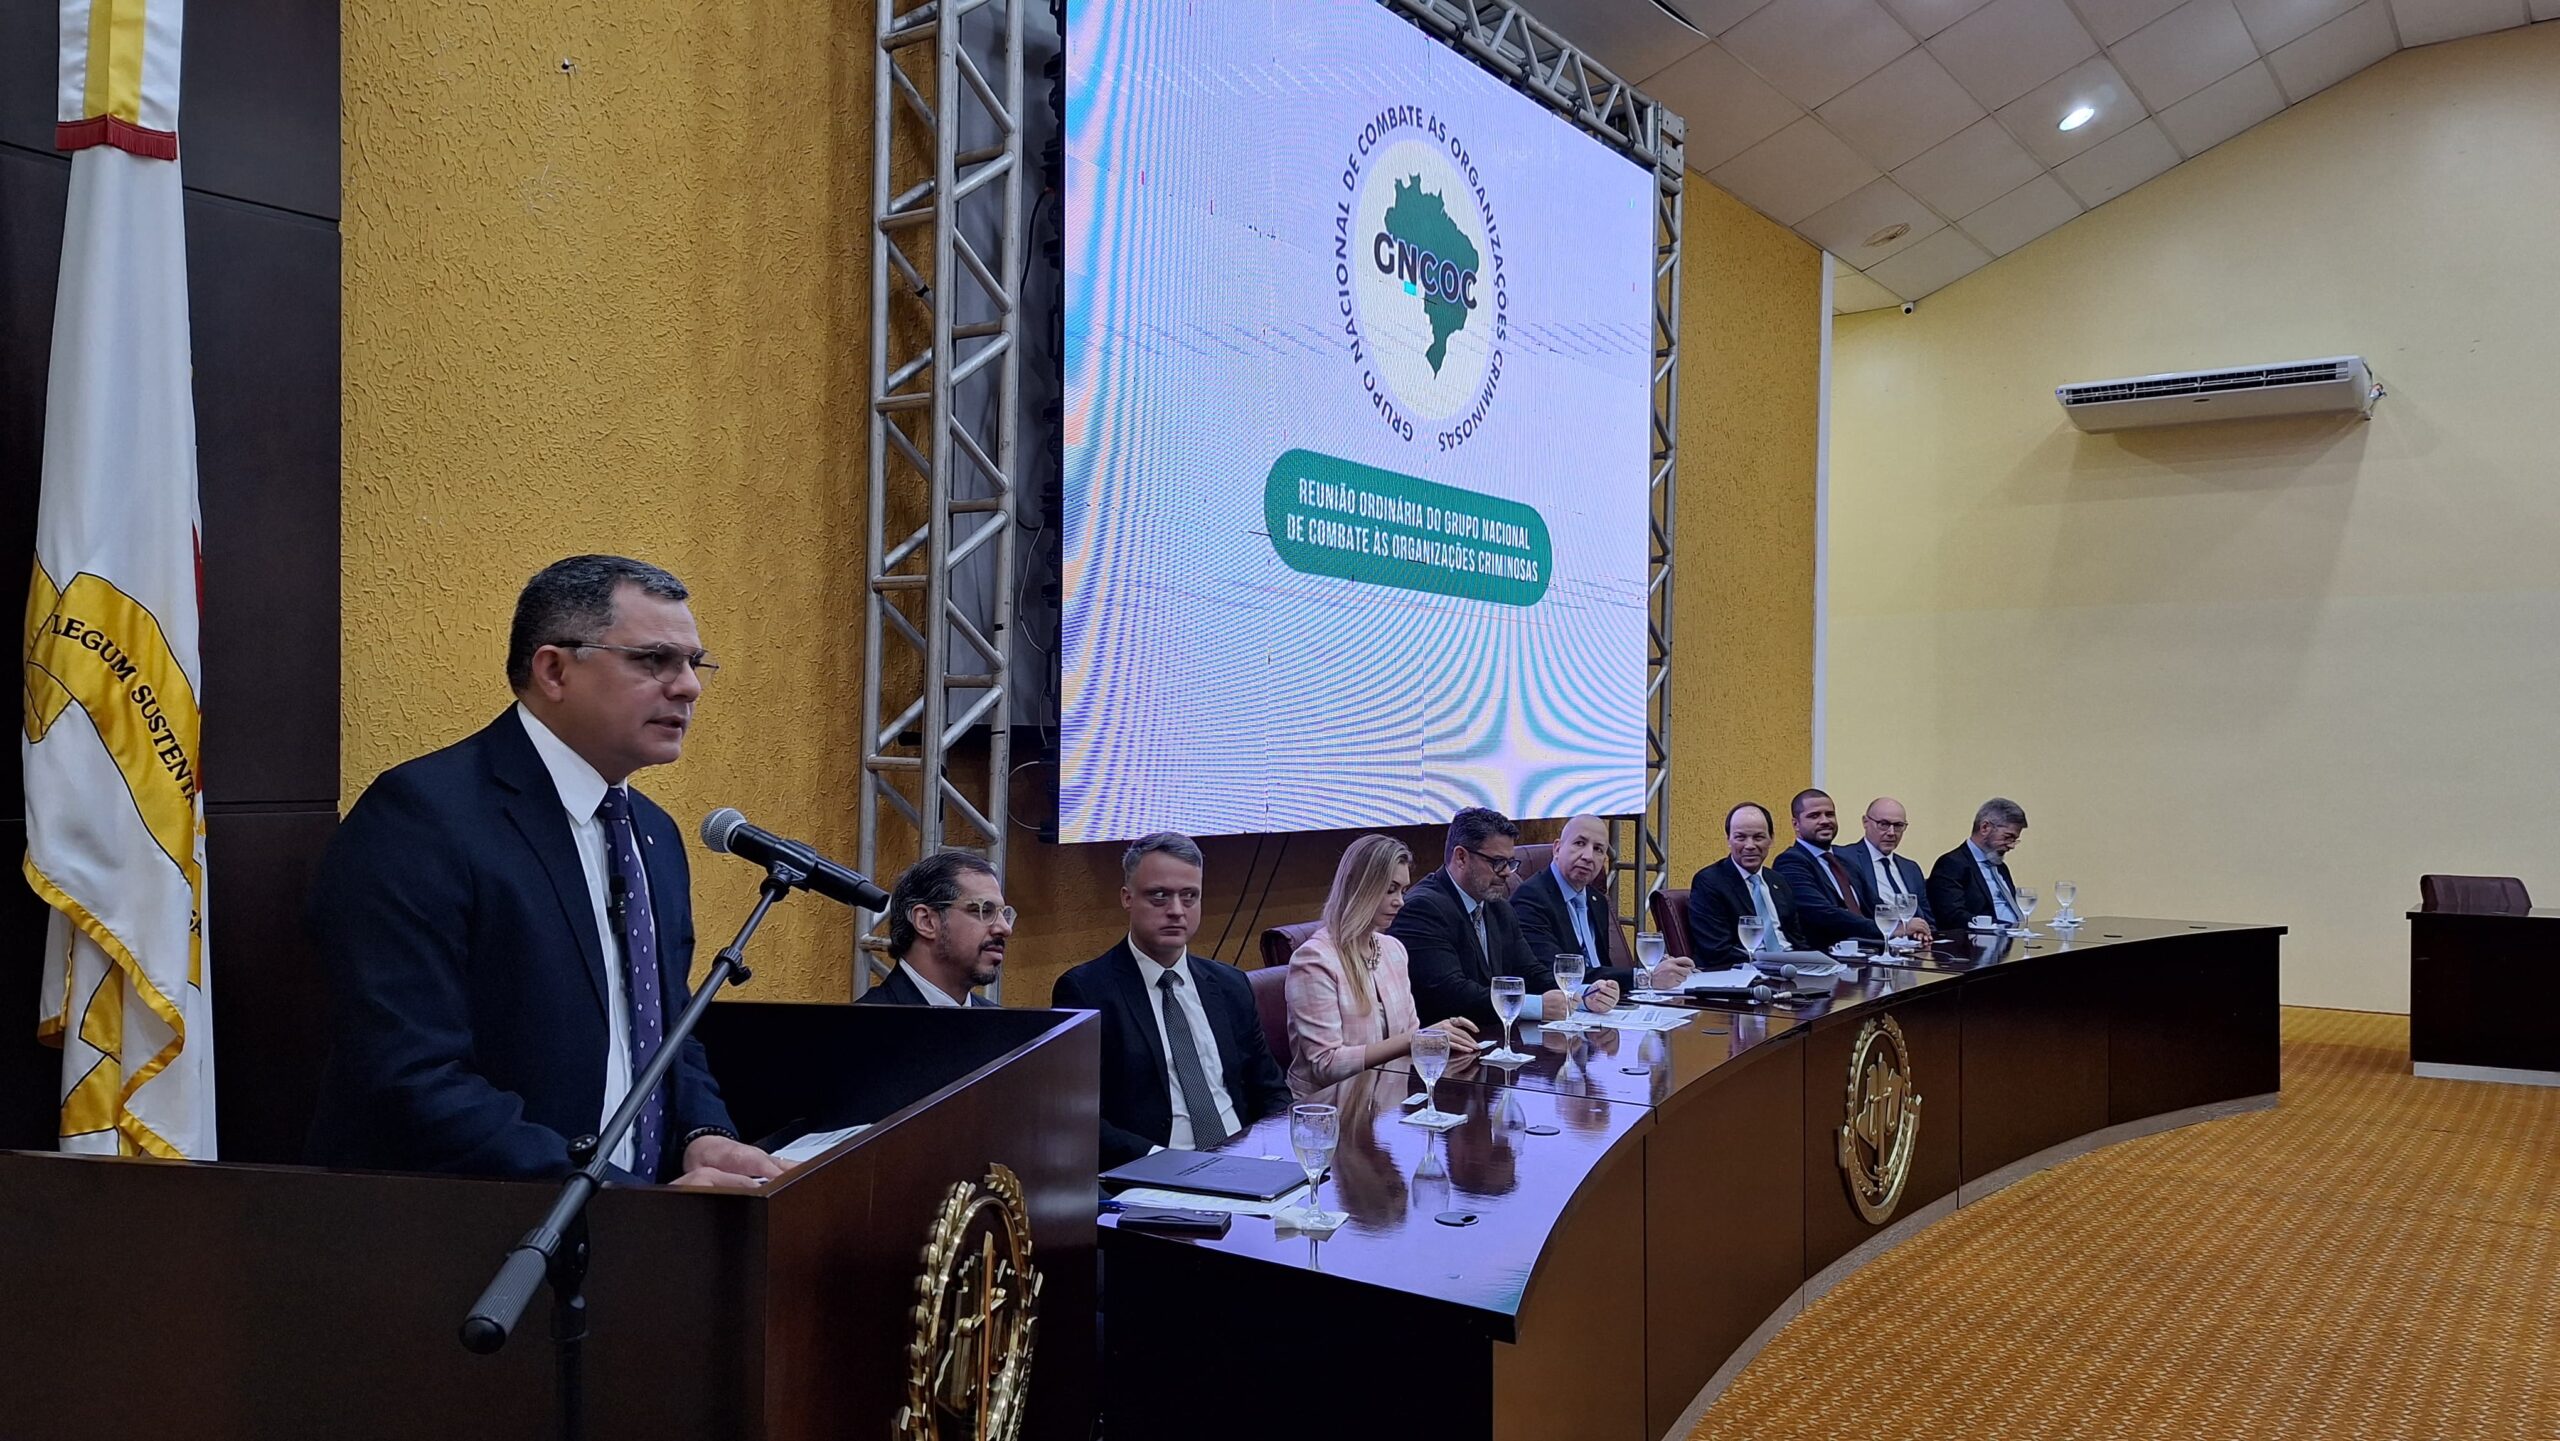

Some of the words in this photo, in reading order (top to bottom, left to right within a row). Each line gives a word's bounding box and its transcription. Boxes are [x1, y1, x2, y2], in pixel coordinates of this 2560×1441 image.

[1357, 104, 1423, 156] COMBATE
[1343, 153, 1360, 192] DE
[1373, 231, 1478, 310] GNCOC
[1451, 137, 1508, 341] ORGANIZAÇÕES
[1335, 201, 1363, 363] NACIONAL
[1362, 370, 1413, 442] GRUPO
[1438, 349, 1504, 452] CRIMINOSAS
[1286, 512, 1305, 543] DE
[1308, 518, 1370, 554] COMBATE
[1373, 525, 1389, 557] ÀS
[1392, 534, 1475, 573] ORGANIZAÇÕES
[1478, 550, 1538, 582] CRIMINOSAS
[1299, 477, 1356, 515] REUNIÃO
[1359, 494, 1424, 529] ORDINÁRIA
[1426, 506, 1442, 532] DO
[1444, 510, 1479, 540] GRUPO
[1482, 518, 1531, 551] NACIONAL
[51, 613, 137, 683] LEGUM
